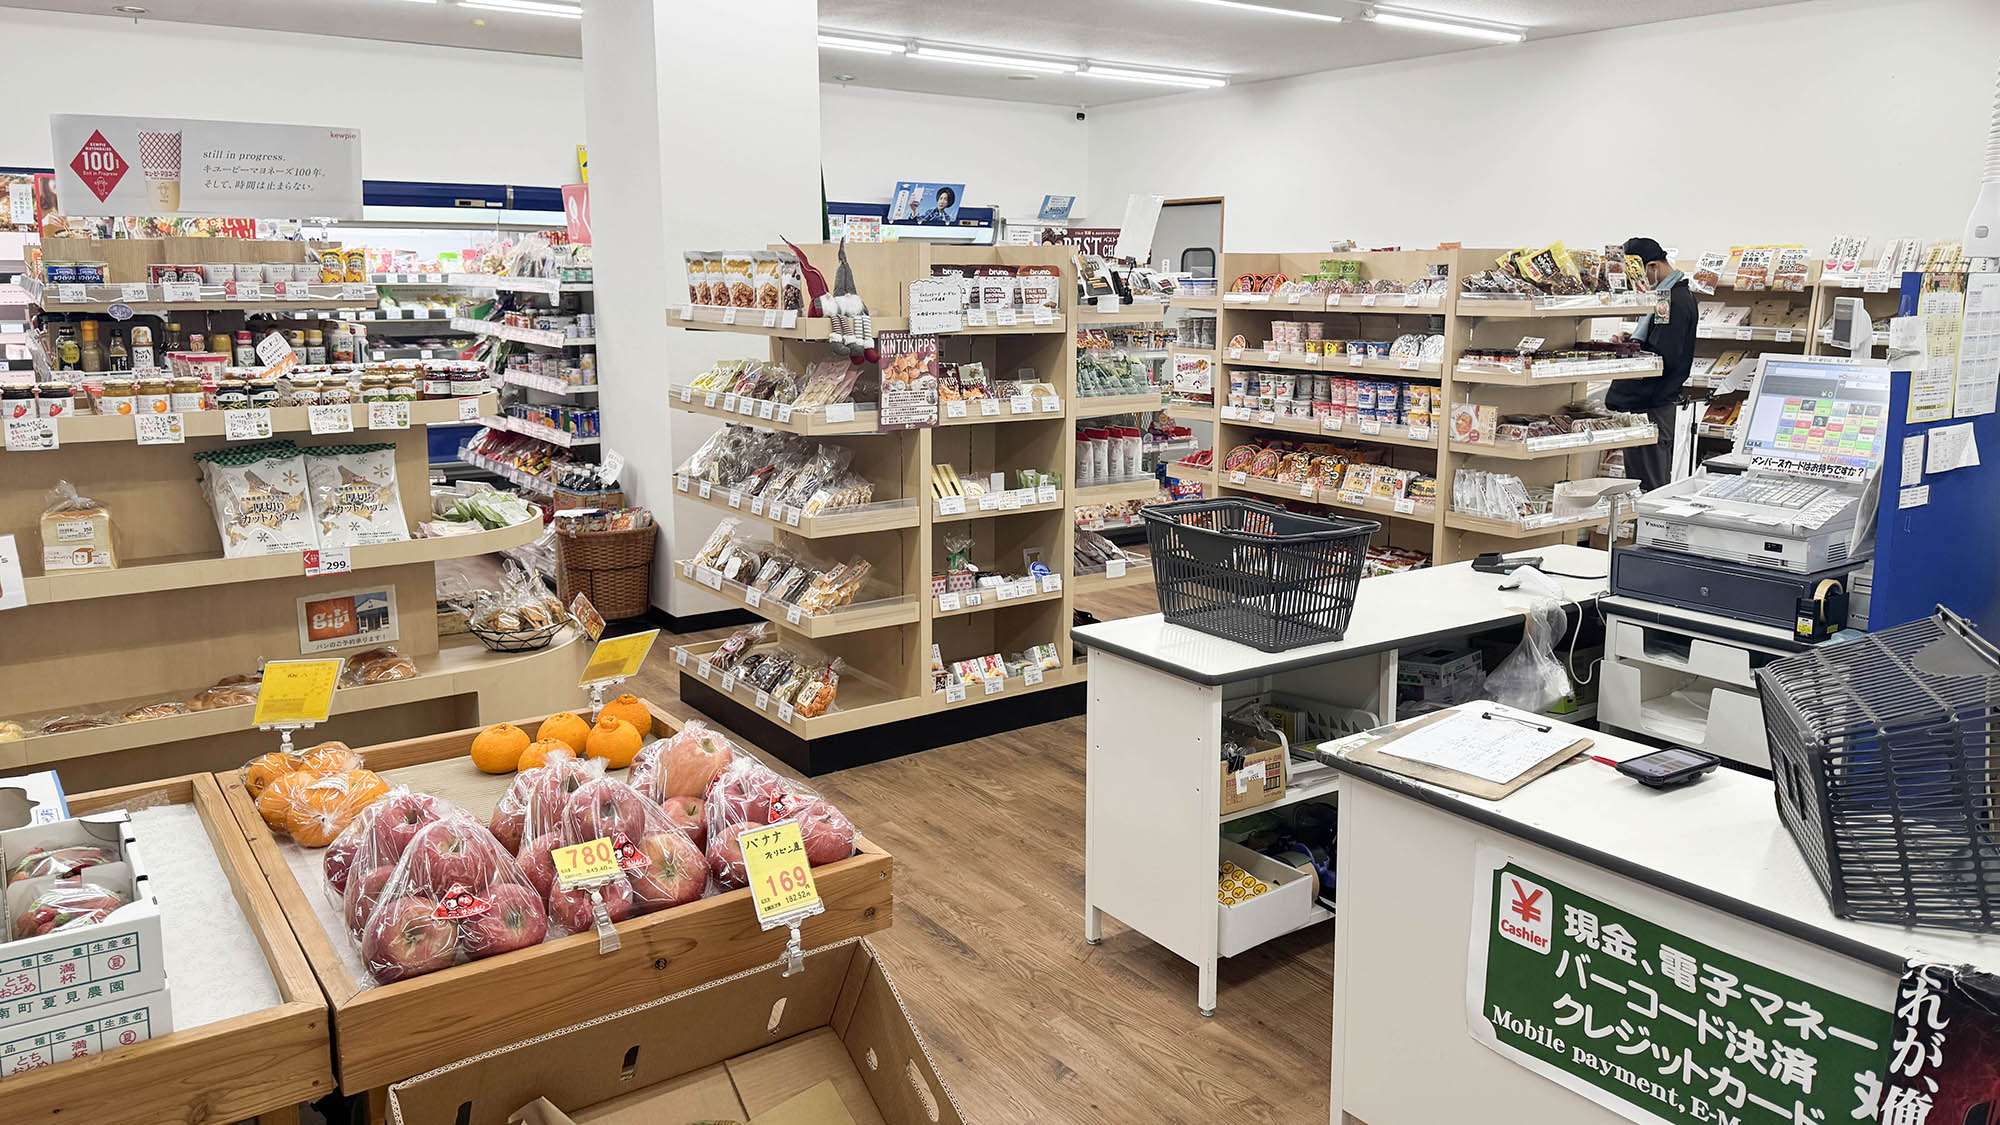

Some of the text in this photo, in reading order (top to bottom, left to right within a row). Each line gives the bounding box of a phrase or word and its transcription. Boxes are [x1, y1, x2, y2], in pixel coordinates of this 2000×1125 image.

[330, 131, 357, 141] kewpie
[202, 150, 287, 162] still in progress.
[204, 179, 315, 192] そして、時間は止まらない。
[880, 338, 937, 354] KINTOKIPPS
[326, 560, 347, 570] 299
[745, 830, 782, 849] バナナ
[1500, 918, 1548, 949] Cashier
[1563, 903, 1879, 1050] 現金、電子マネー
[1555, 949, 1818, 1095] バーコード決済
[1492, 1004, 1566, 1056] Mobile
[1572, 1042, 1687, 1114] payment,
[1552, 992, 1826, 1125] クレジットカード
